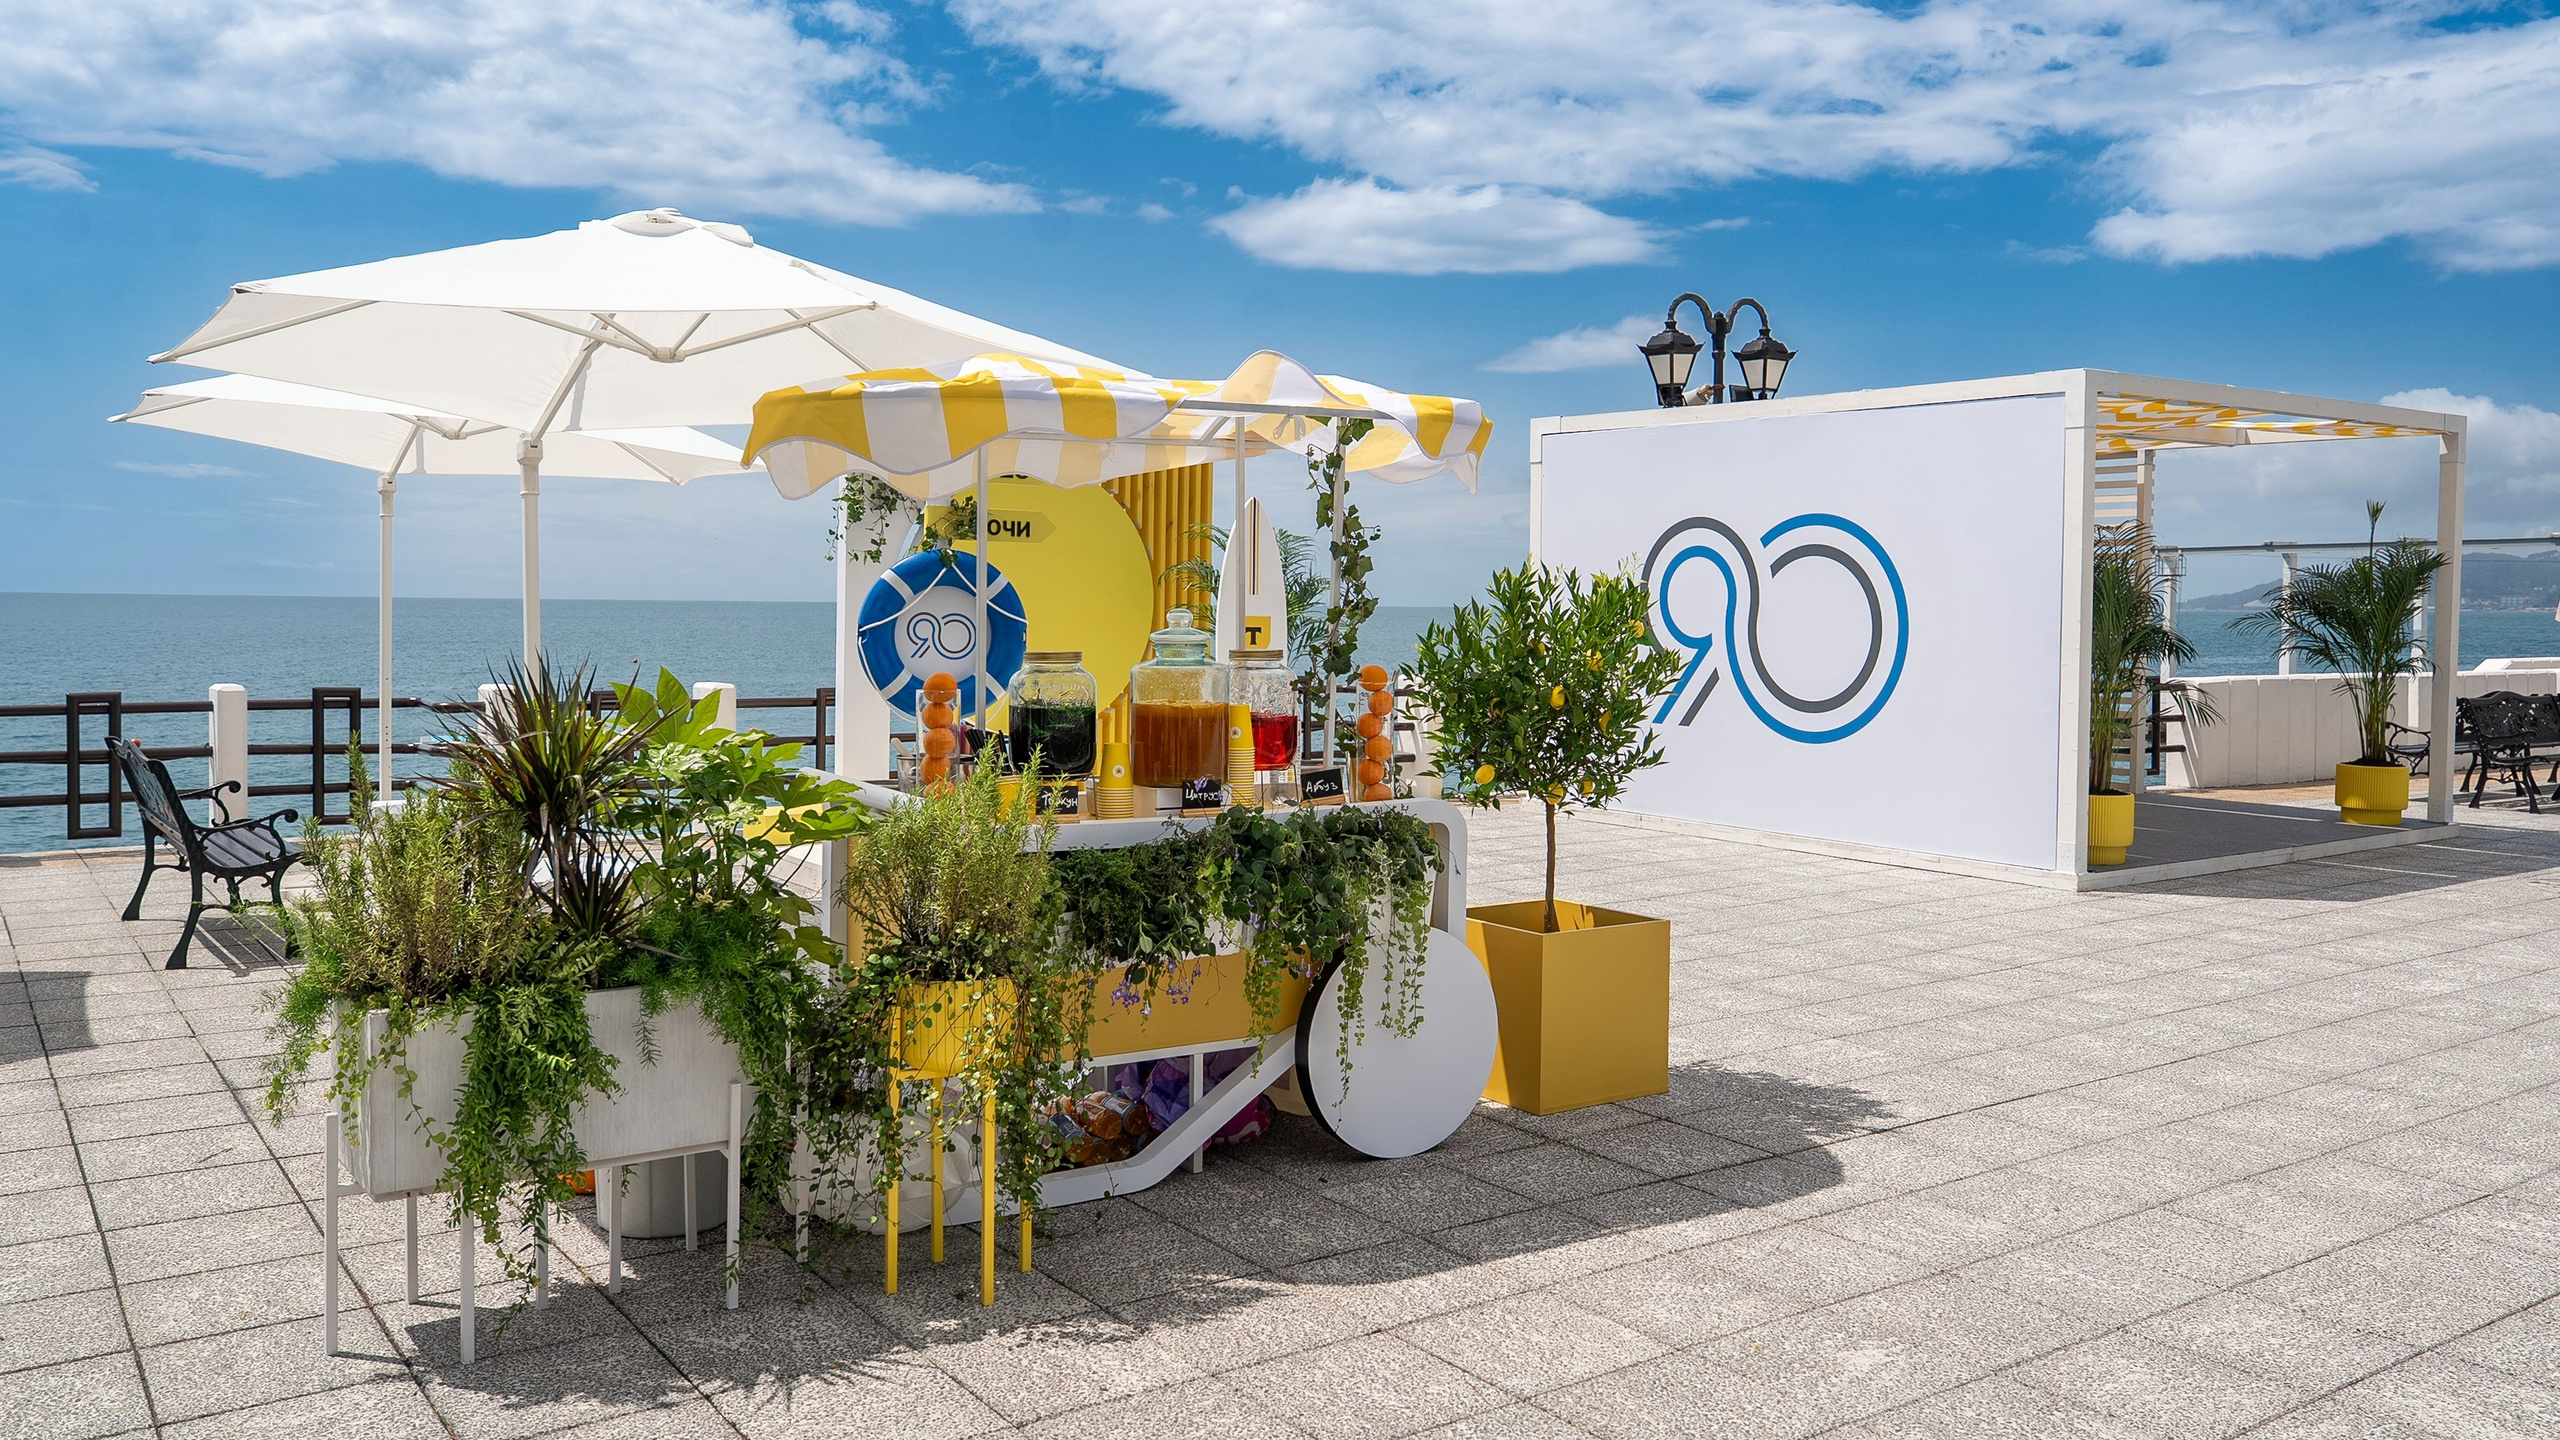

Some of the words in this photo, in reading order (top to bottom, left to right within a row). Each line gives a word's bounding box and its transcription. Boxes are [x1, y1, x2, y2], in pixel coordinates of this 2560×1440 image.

[987, 519, 1031, 538] ОЧИ
[906, 612, 977, 660] 90
[1640, 513, 1909, 744] 90
[1185, 788, 1220, 801] Цитрус
[1305, 779, 1338, 793] Арбуз
